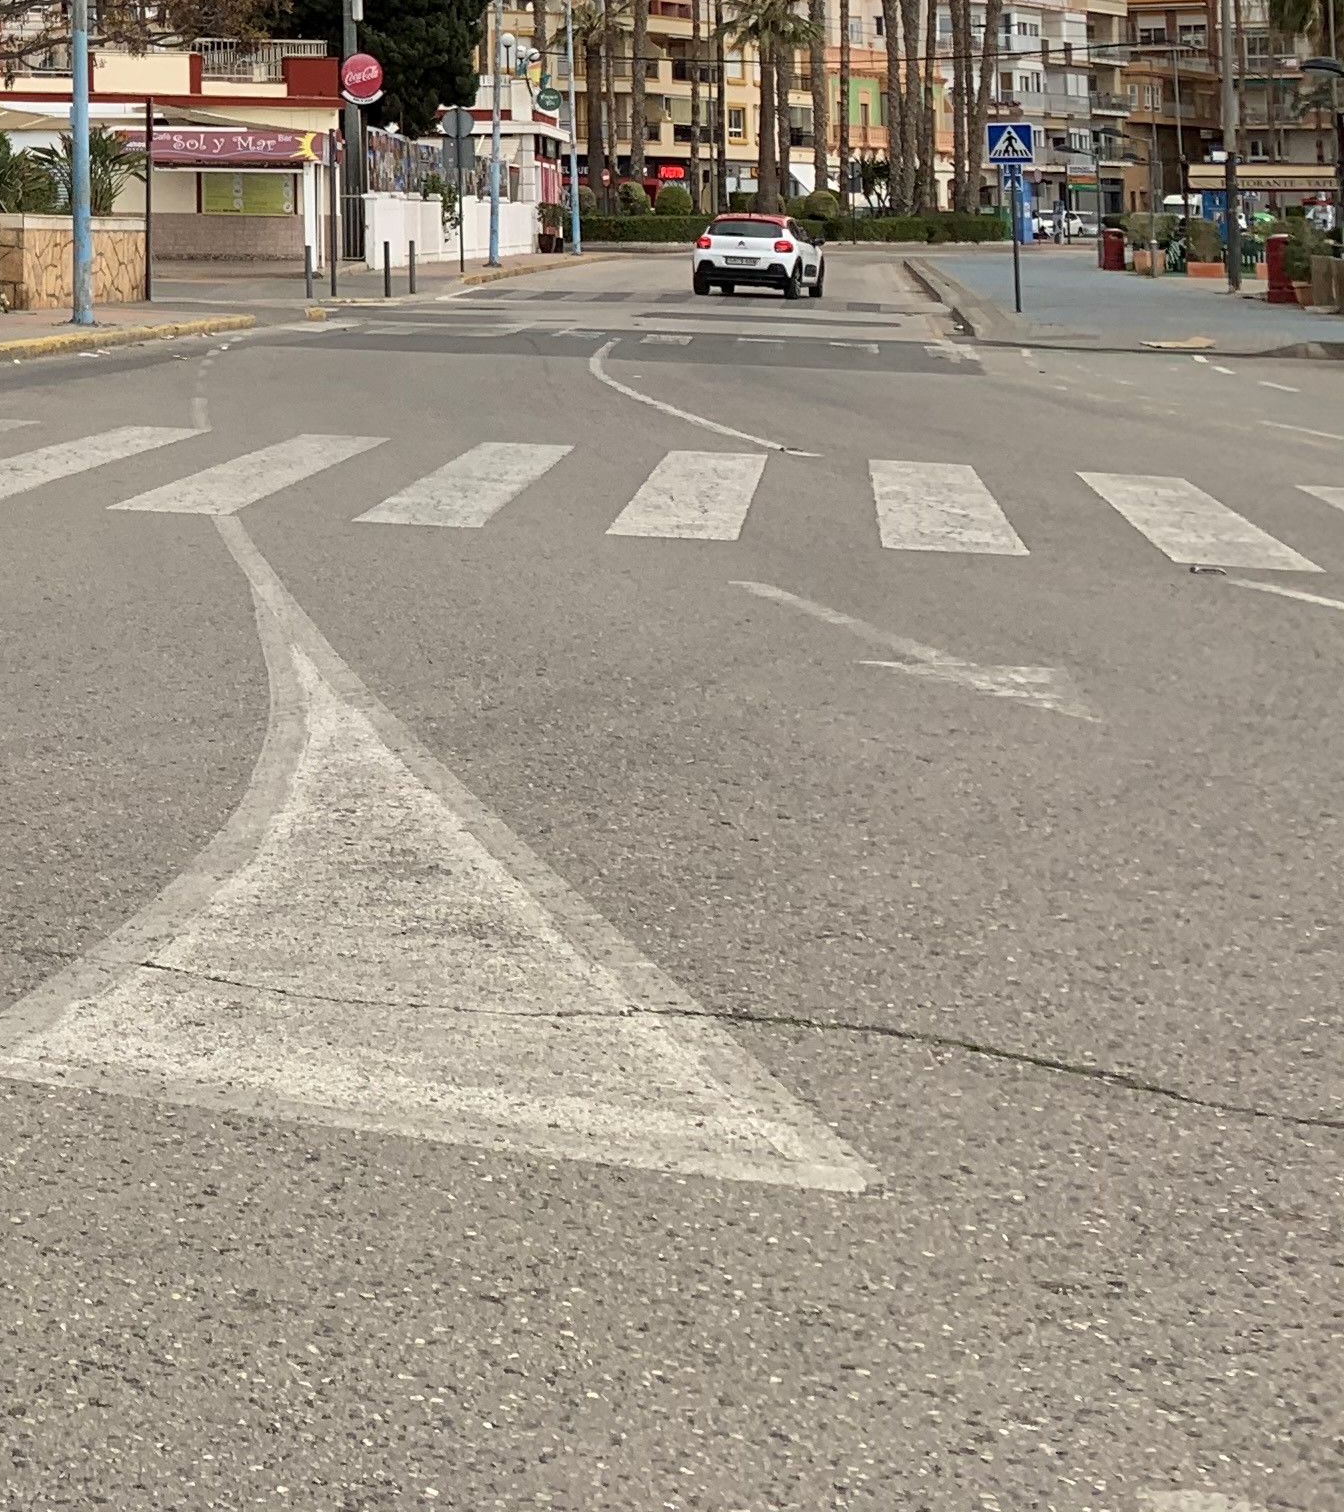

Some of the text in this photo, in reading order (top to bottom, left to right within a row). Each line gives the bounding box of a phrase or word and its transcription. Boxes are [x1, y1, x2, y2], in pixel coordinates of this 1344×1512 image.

[172, 134, 207, 151] Sol
[212, 137, 225, 154] y
[233, 136, 277, 152] Mar
